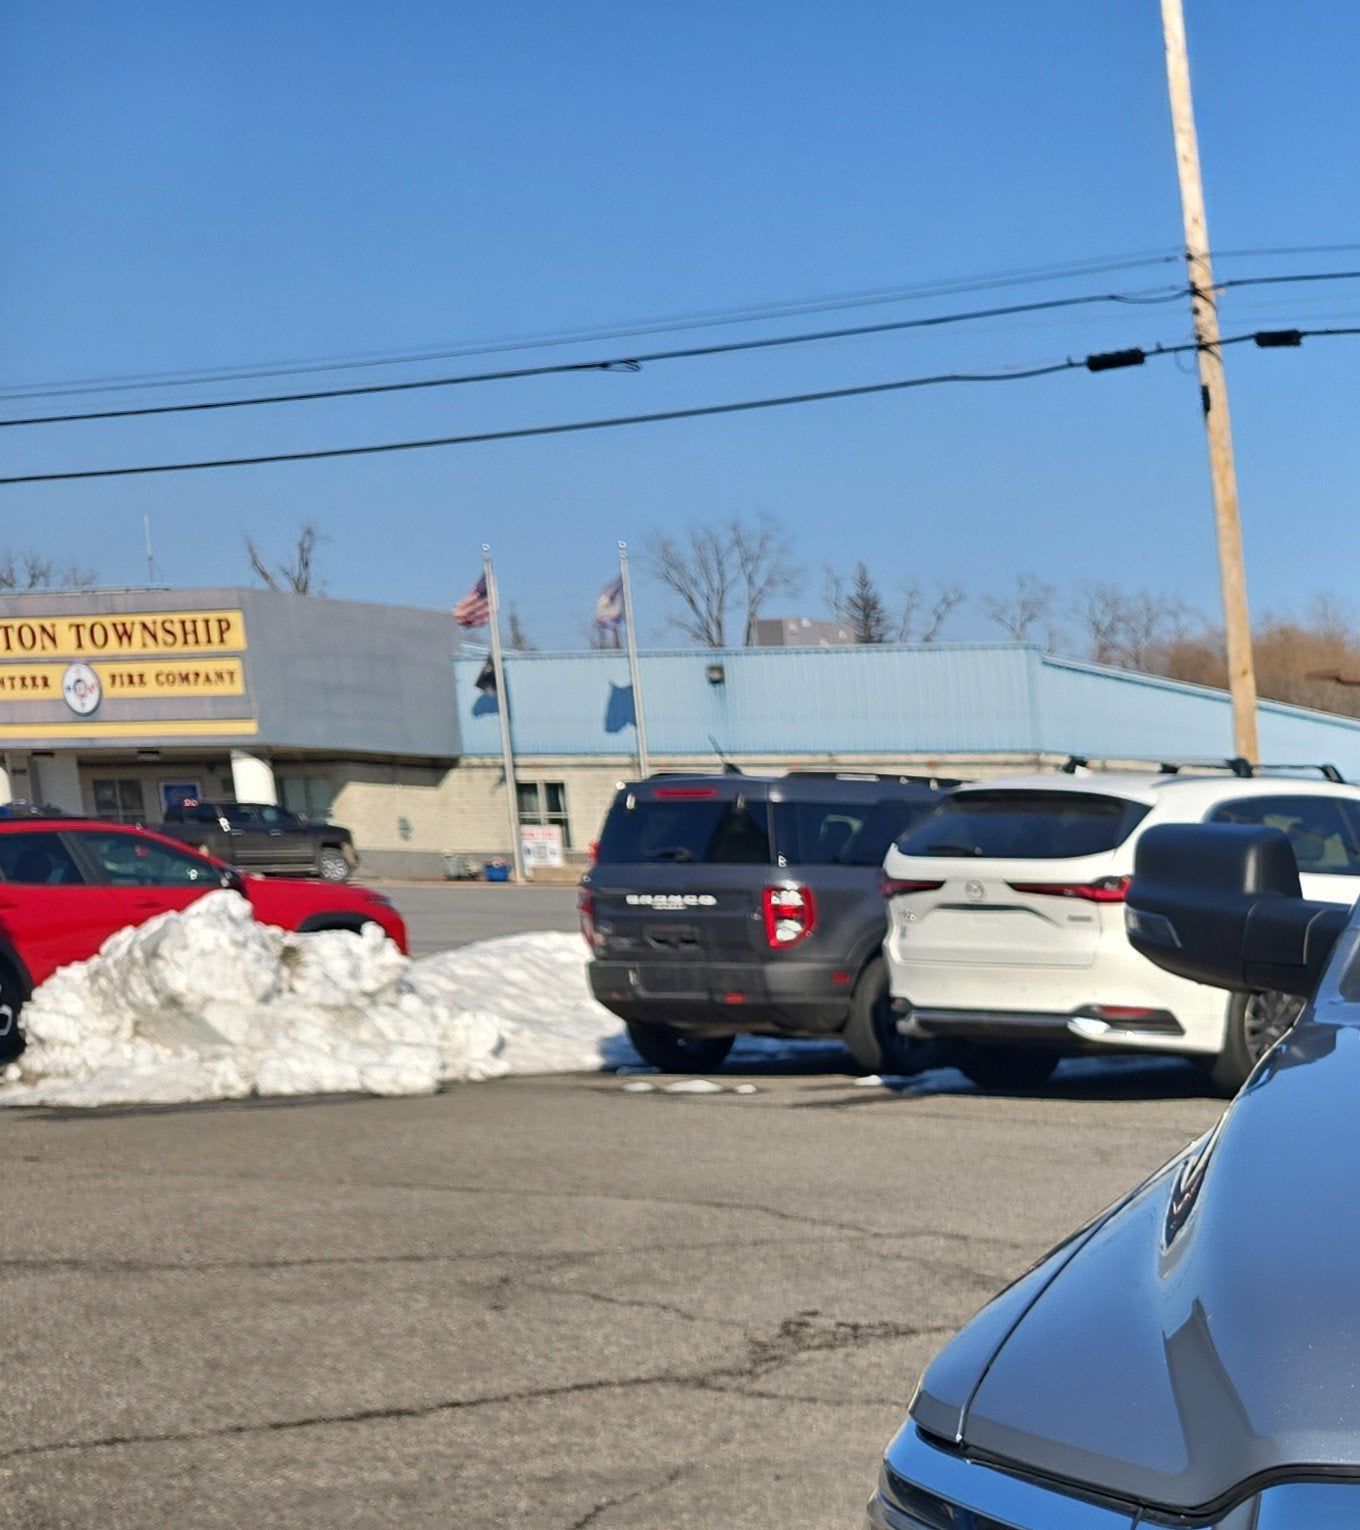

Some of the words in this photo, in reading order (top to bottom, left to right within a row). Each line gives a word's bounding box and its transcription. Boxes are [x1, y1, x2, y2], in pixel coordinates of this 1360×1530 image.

[0, 622, 58, 651] TON
[68, 617, 232, 650] TOWNSHIP
[109, 672, 147, 689] FIRE
[155, 669, 237, 687] COMPANY
